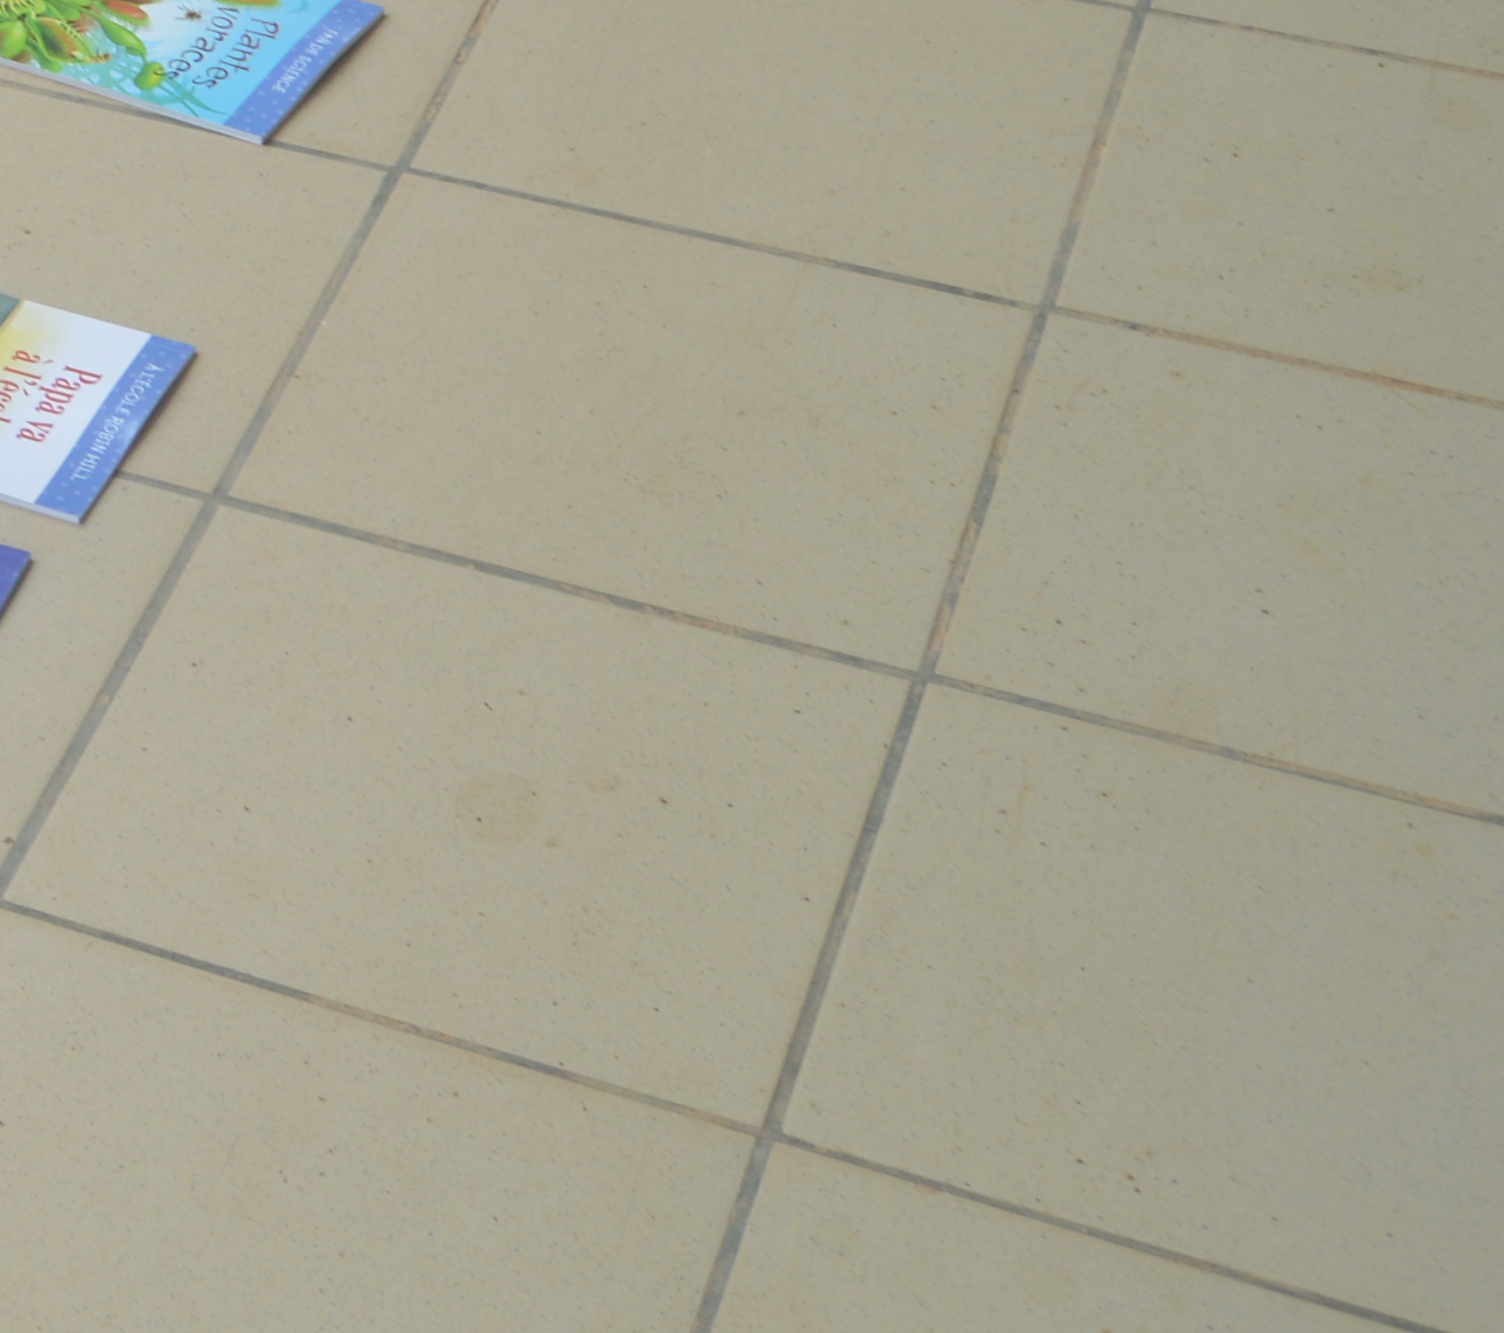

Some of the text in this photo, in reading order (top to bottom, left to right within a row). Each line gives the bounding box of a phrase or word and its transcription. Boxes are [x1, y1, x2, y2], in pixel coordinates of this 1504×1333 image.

[150, 7, 239, 81] voraces
[191, 17, 281, 89] Plantes
[12, 350, 53, 363] à
[16, 365, 102, 442] Papa va
